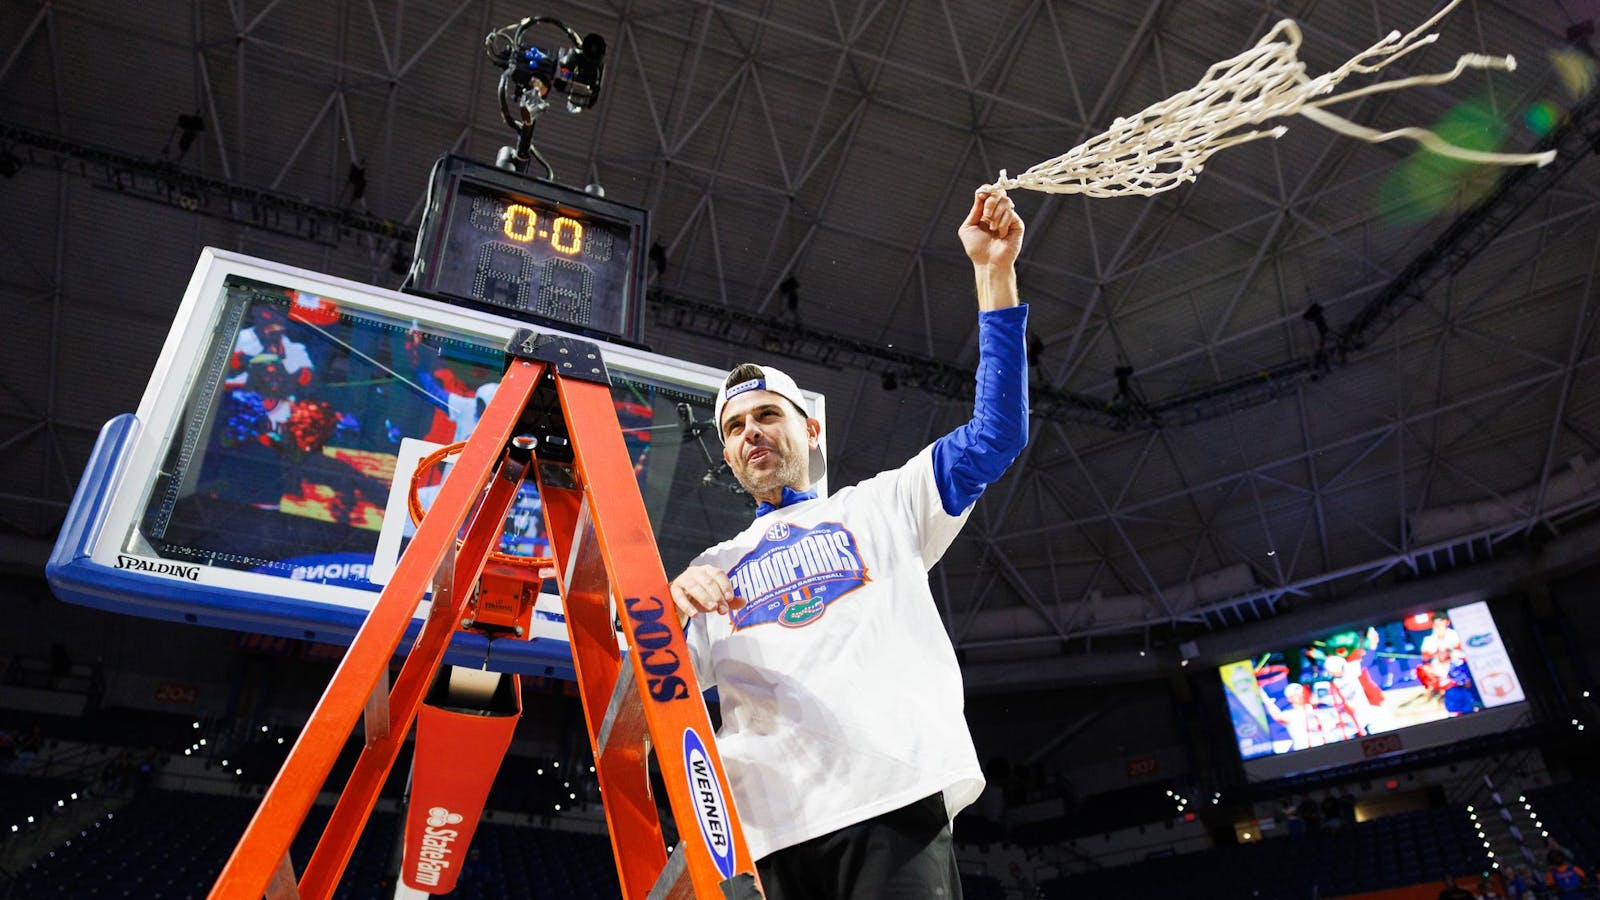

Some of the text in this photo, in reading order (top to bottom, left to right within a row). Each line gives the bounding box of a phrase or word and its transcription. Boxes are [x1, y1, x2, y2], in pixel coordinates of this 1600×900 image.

[768, 522, 788, 540] SEC
[114, 555, 200, 580] SPALDING
[746, 593, 774, 610] FLORIDA
[798, 573, 844, 587] BASKETBALL
[813, 585, 827, 594] 26
[767, 601, 781, 611] 20
[624, 596, 690, 703] SCOC
[693, 760, 727, 847] WERNER
